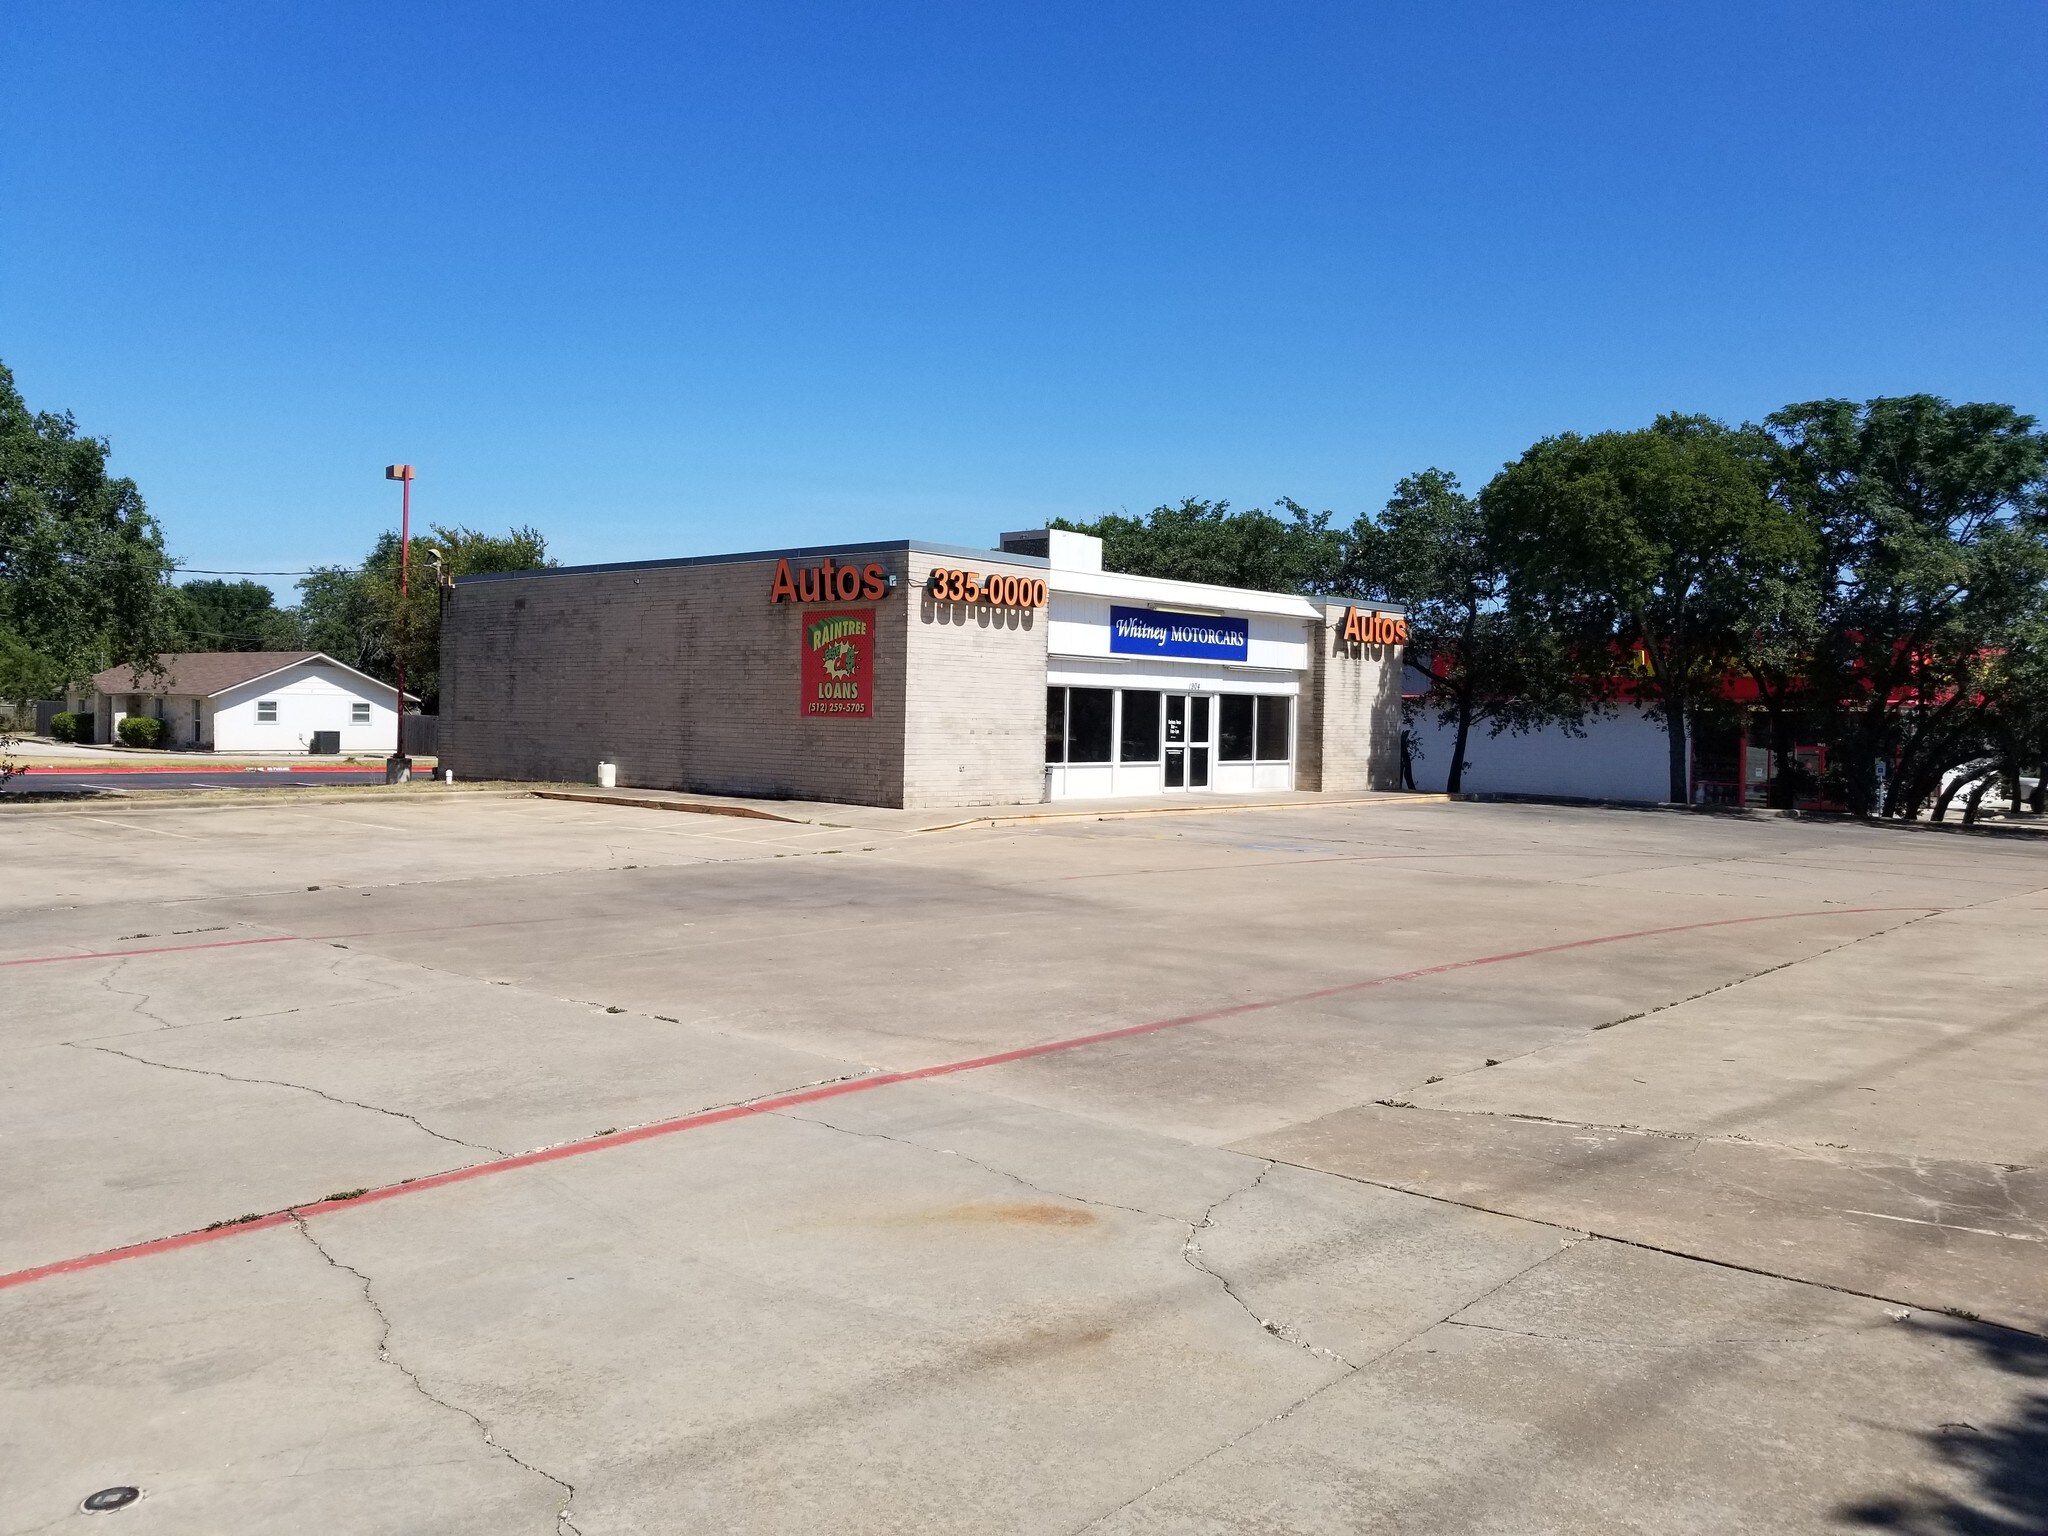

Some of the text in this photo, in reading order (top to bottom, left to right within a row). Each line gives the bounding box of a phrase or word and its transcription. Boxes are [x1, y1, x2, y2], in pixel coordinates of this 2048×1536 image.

[771, 558, 888, 603] Autos
[931, 568, 1047, 607] 335-0000
[811, 618, 866, 651] RAINTREE
[1116, 617, 1244, 646] Whitney MOTORCARS
[1343, 606, 1407, 645] Autos
[818, 682, 858, 700] LOANS
[808, 703, 865, 714] (512) 259-5705
